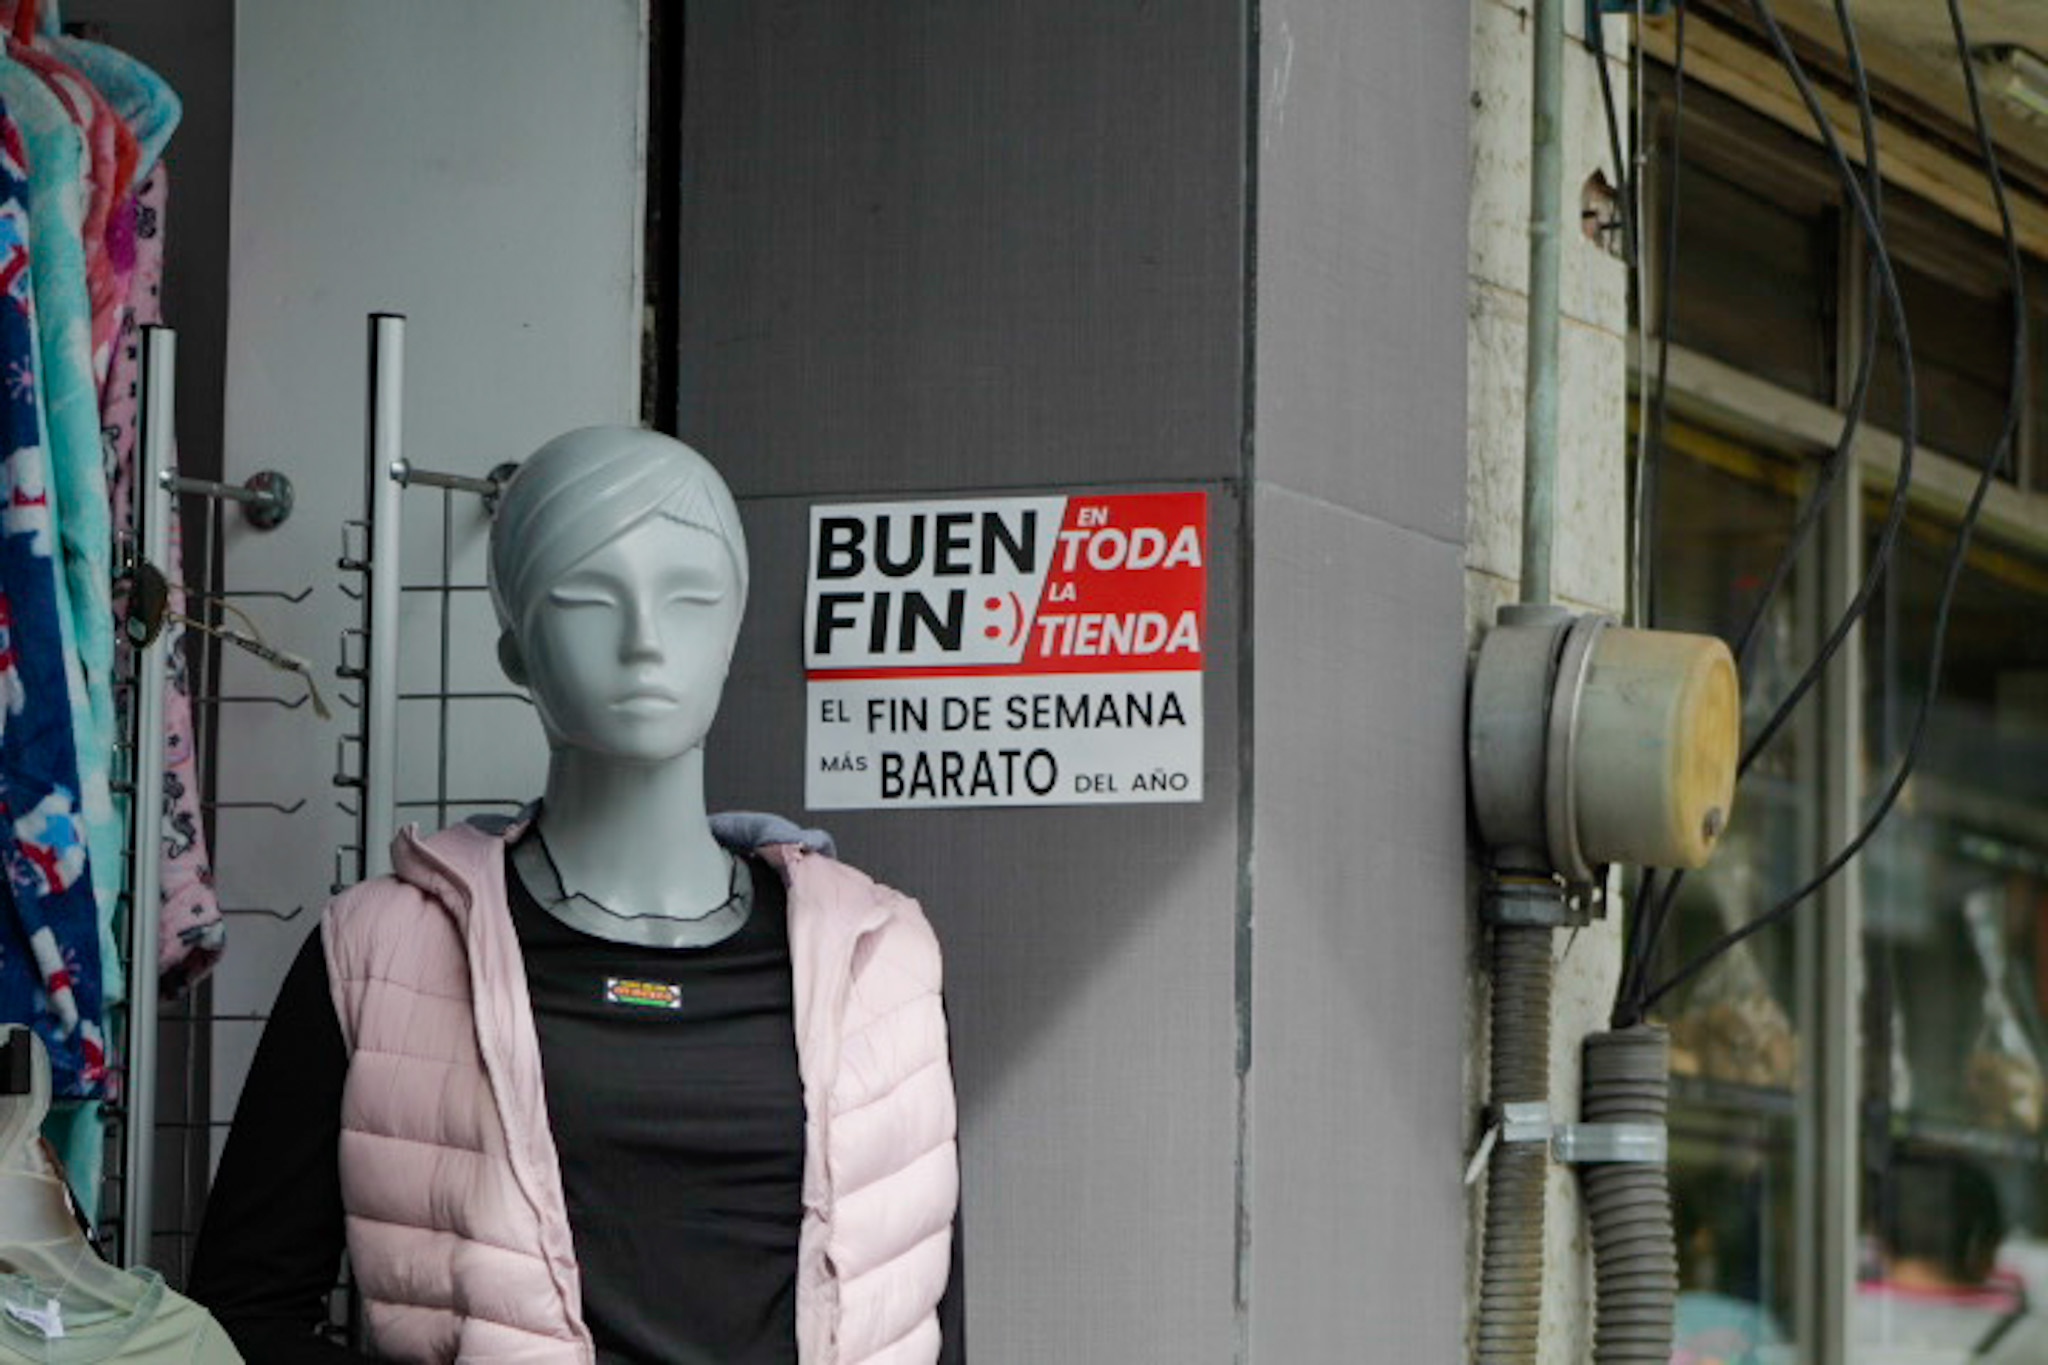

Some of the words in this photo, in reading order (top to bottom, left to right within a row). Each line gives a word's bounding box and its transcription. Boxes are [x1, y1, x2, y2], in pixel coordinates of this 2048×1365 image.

[1077, 507, 1107, 526] EN
[816, 510, 1037, 580] BUEN
[1060, 526, 1201, 572] TODA
[1048, 582, 1077, 601] LA
[814, 589, 966, 654] FIN
[1037, 611, 1200, 657] TIENDA
[821, 700, 850, 723] EL
[867, 697, 928, 733] FIN
[942, 696, 991, 732] DE
[1006, 691, 1187, 730] SEMANA
[820, 752, 868, 772] MÁS
[880, 748, 1058, 799] BARATO
[1075, 773, 1118, 793] DEL
[1131, 768, 1189, 791] AÑO
